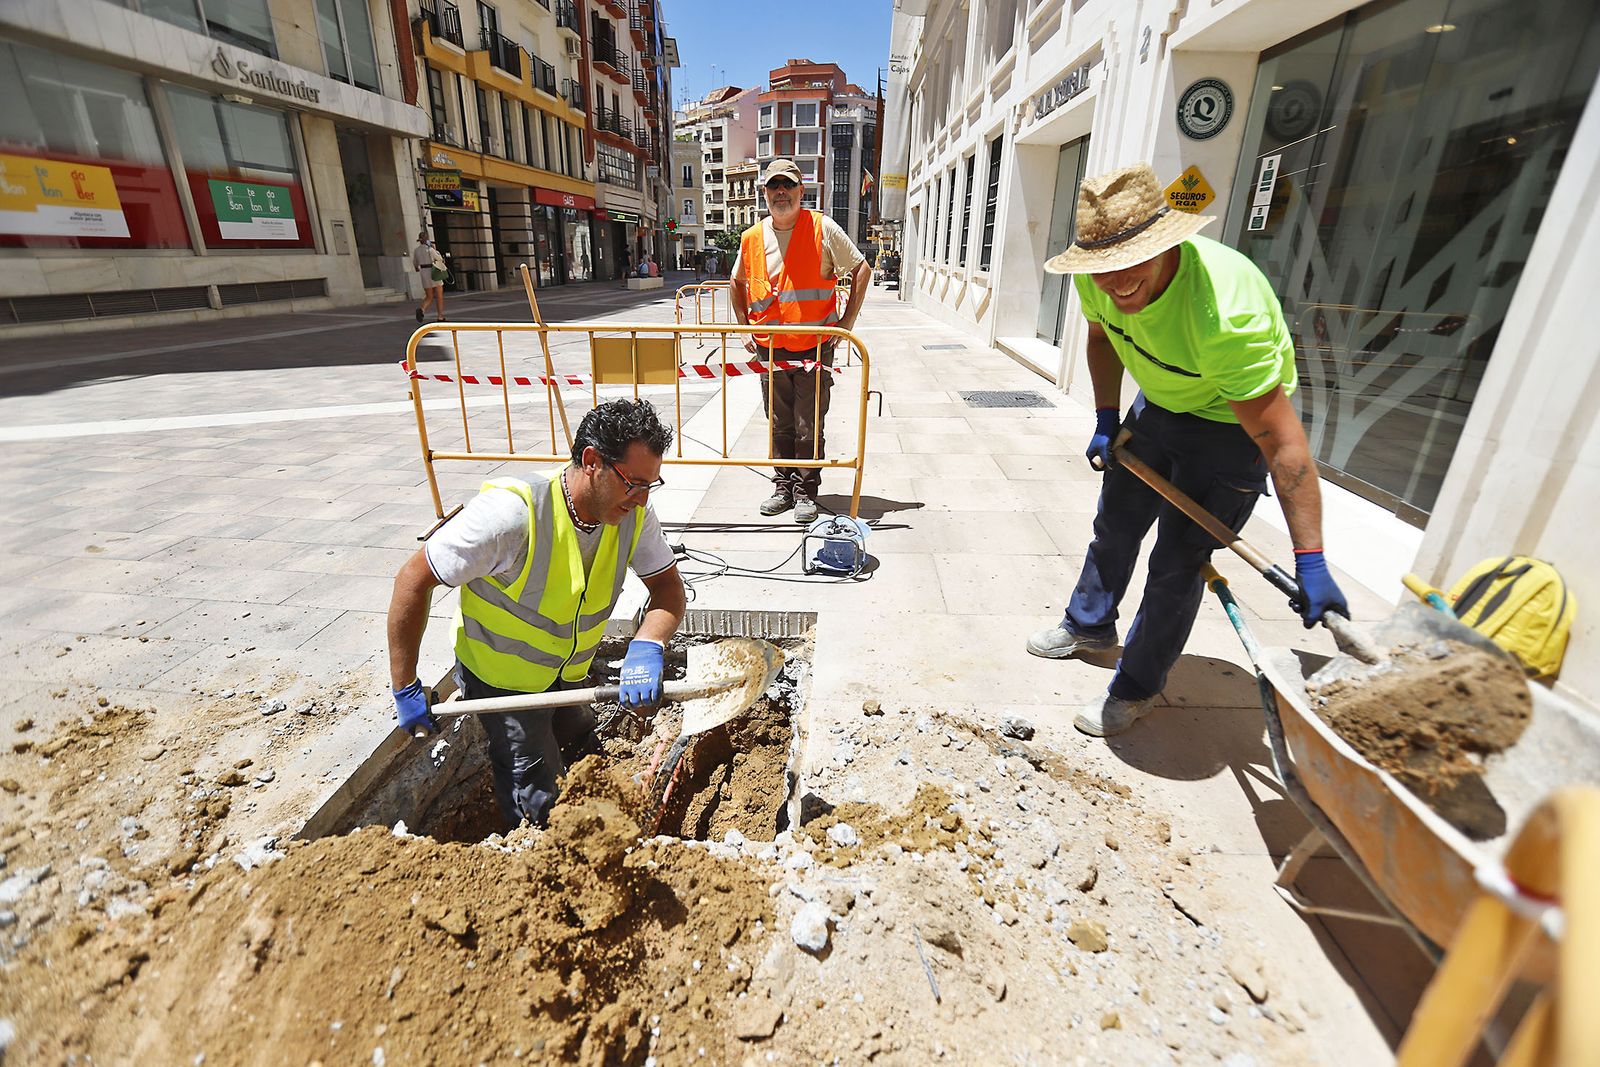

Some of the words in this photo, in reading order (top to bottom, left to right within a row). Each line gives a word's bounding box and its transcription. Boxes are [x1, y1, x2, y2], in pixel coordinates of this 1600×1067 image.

[1139, 25, 1152, 55] 2
[237, 60, 320, 104] Santander
[247, 188, 255, 197] te
[1170, 192, 1206, 201] SEGUROS
